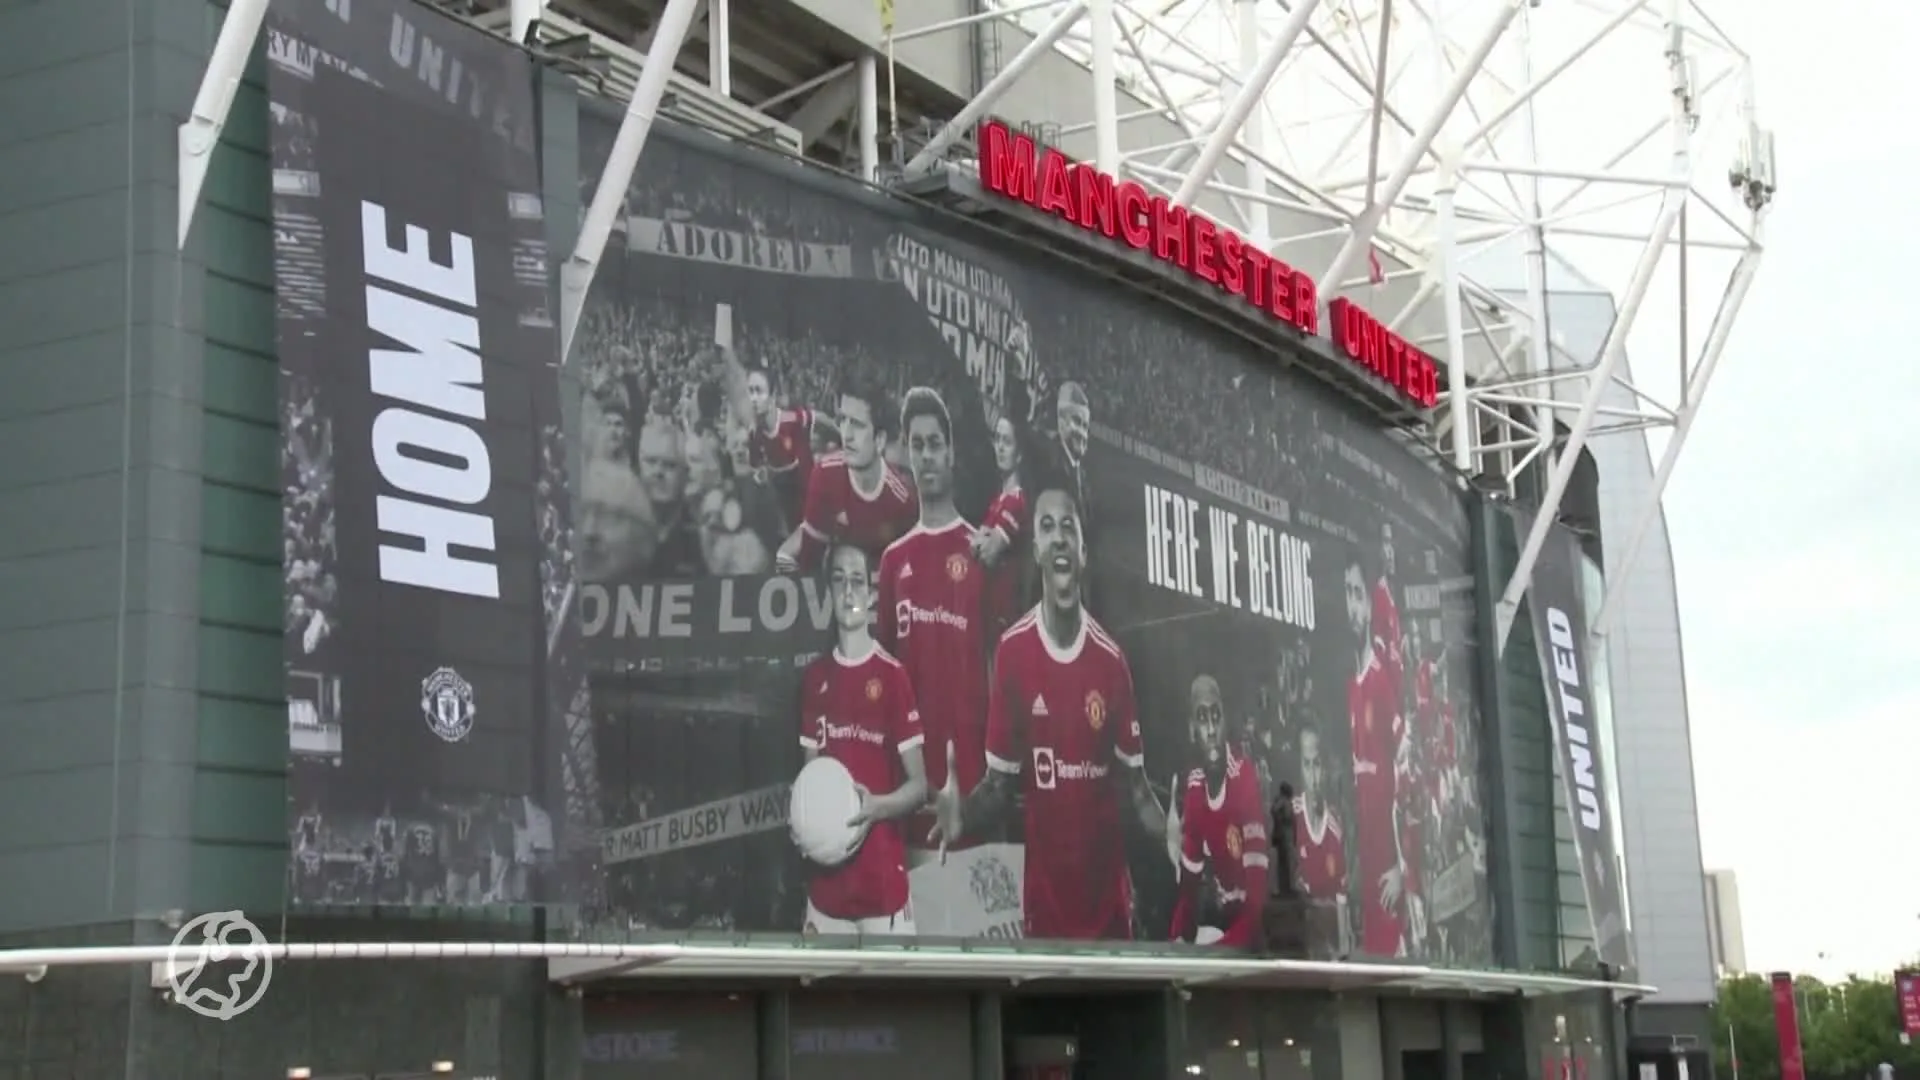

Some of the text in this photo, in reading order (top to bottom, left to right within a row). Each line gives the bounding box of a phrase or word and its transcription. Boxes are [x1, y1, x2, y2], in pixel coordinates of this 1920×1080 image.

[656, 220, 812, 273] ADORED
[934, 248, 967, 287] MAN
[979, 119, 1439, 407] MANCHESTER UNITED
[361, 200, 499, 598] HOME
[1144, 484, 1203, 598] HERE
[1208, 505, 1242, 609] WE
[1246, 519, 1316, 632] BELONG
[580, 583, 694, 638] ONE
[826, 722, 885, 746] TeamViewer
[1547, 607, 1600, 831] UNITED
[619, 822, 664, 857] MATT
[668, 803, 731, 844] BUSBY
[740, 792, 788, 825] WAY
